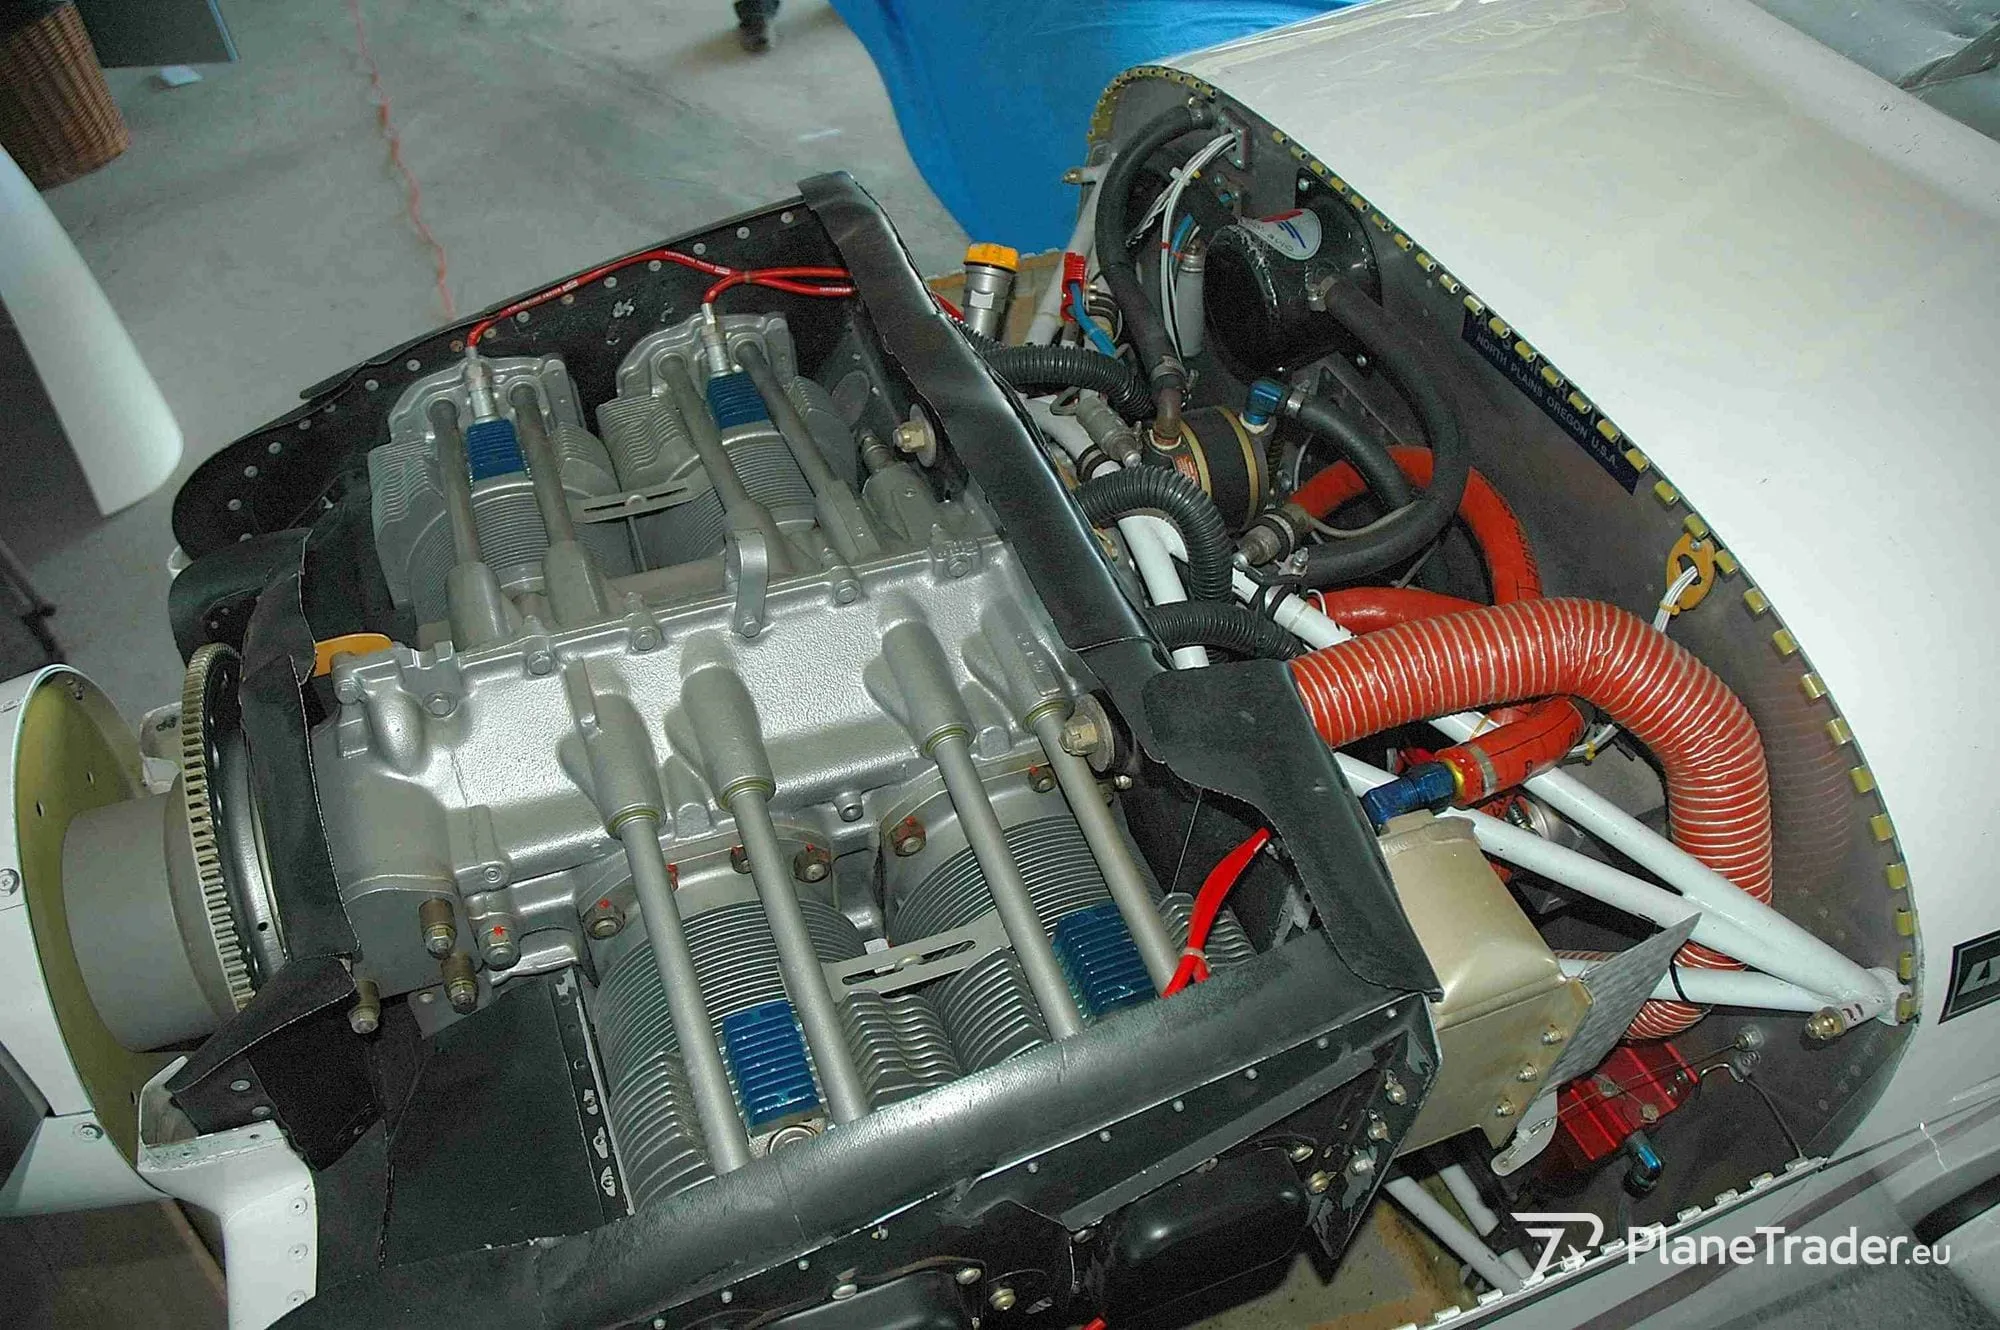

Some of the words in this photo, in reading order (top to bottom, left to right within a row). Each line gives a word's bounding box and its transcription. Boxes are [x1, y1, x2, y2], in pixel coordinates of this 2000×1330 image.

[1476, 332, 1508, 366] NORTH
[1510, 362, 1543, 398] PLAINS
[1546, 396, 1589, 439] OREGON
